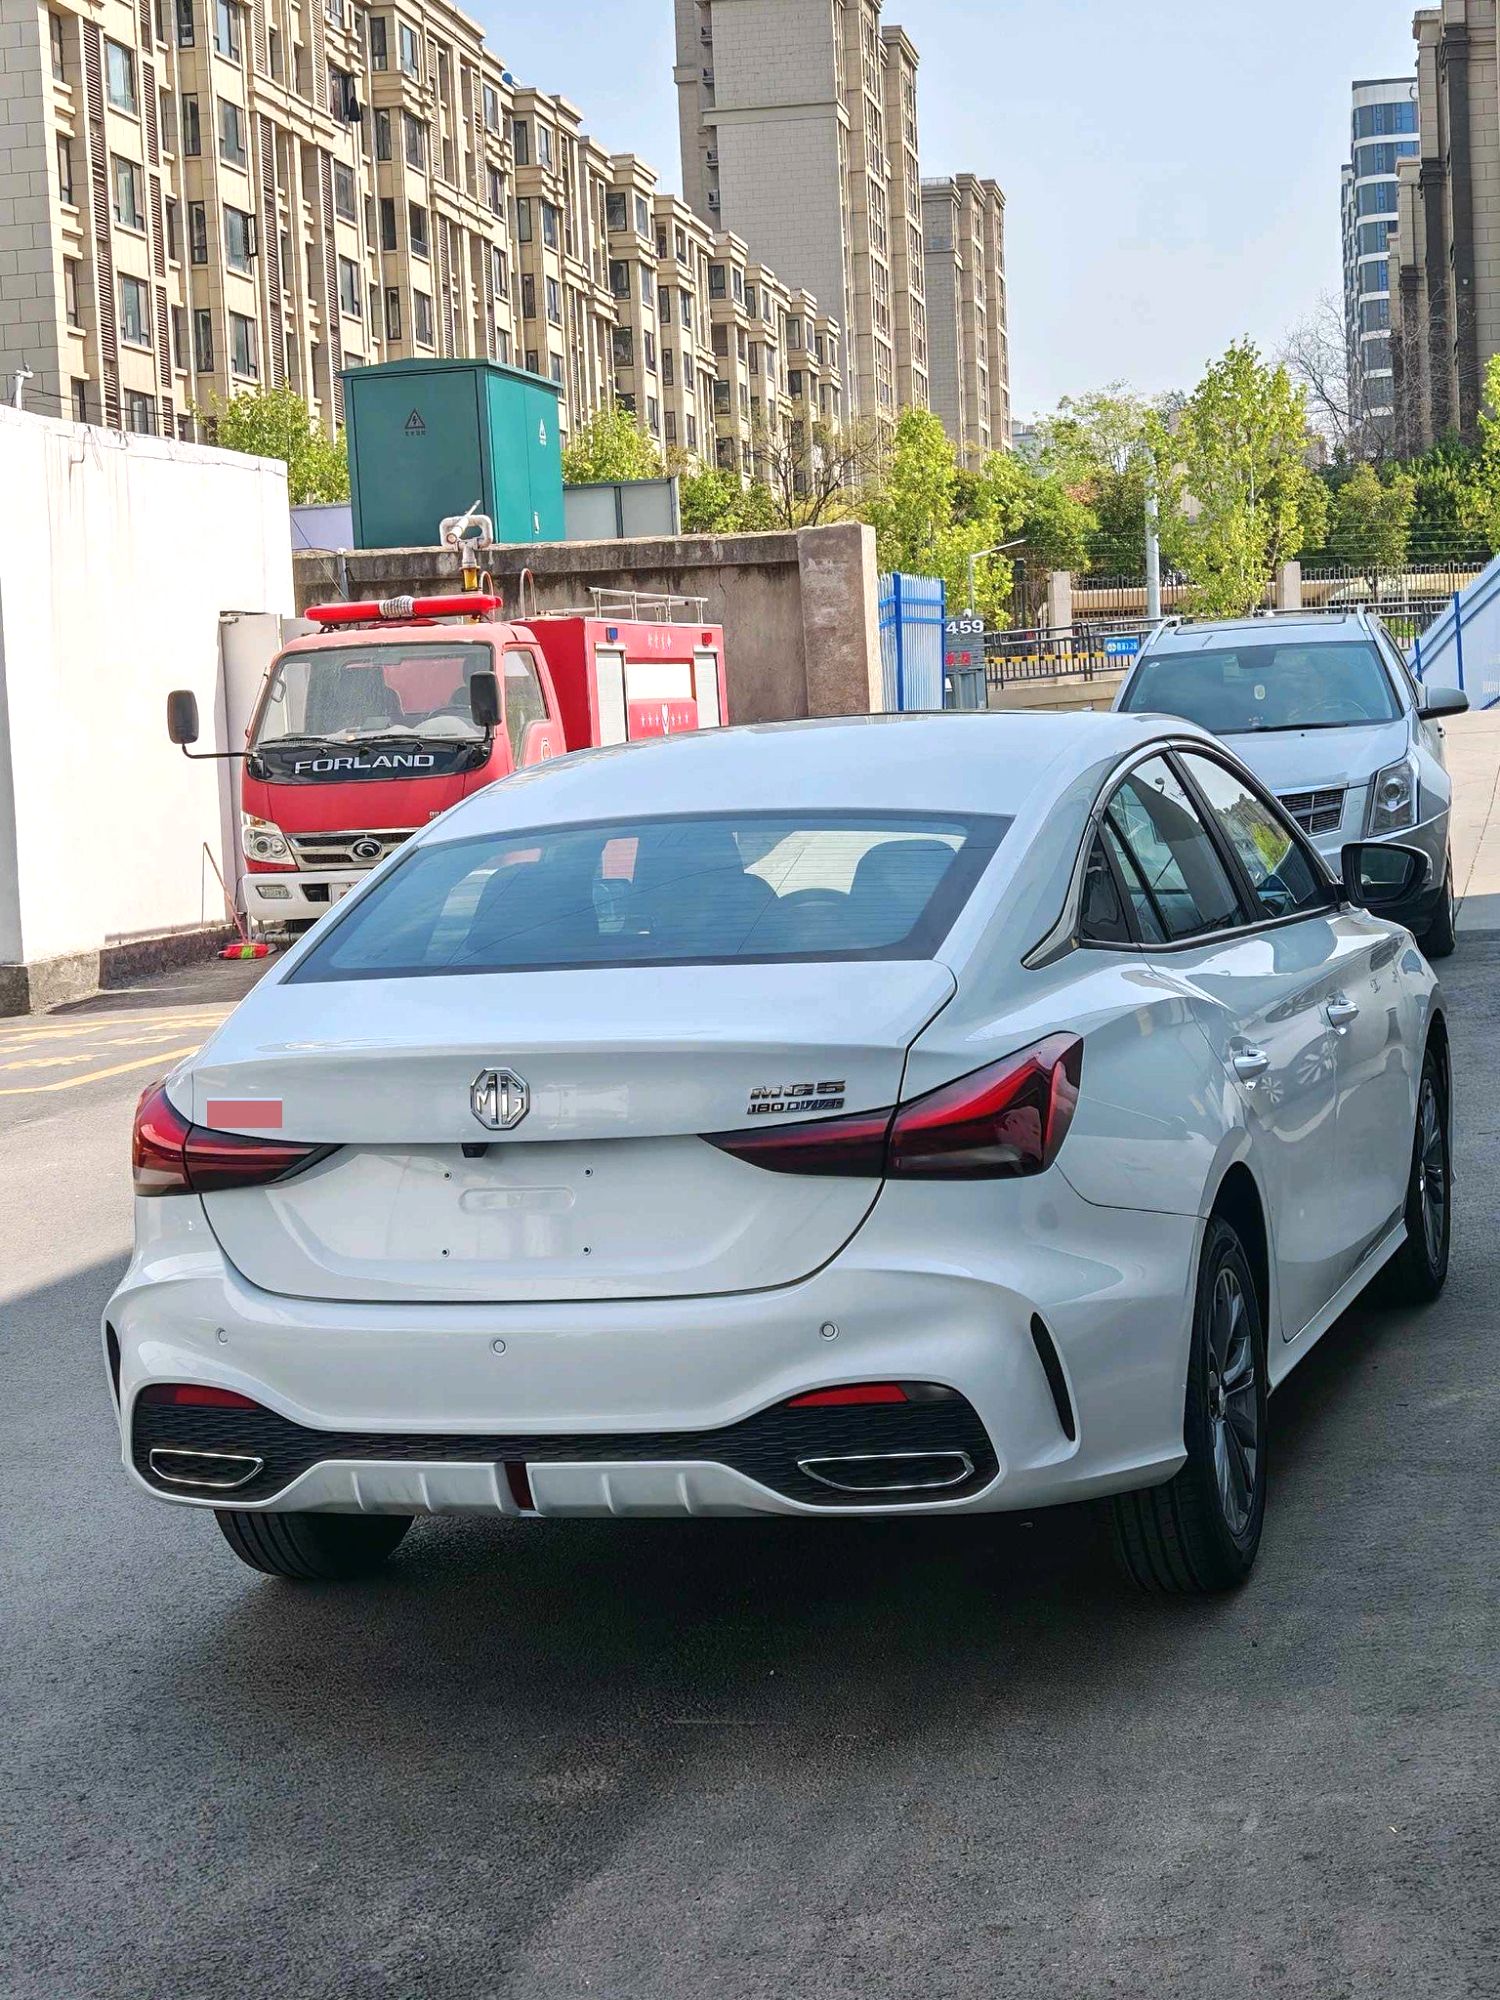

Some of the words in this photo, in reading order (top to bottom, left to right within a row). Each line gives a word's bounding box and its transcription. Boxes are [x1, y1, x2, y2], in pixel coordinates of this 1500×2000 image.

[945, 619, 984, 635] 459
[294, 754, 435, 774] FORLAND
[475, 1072, 525, 1126] MG
[750, 1080, 846, 1100] MG5
